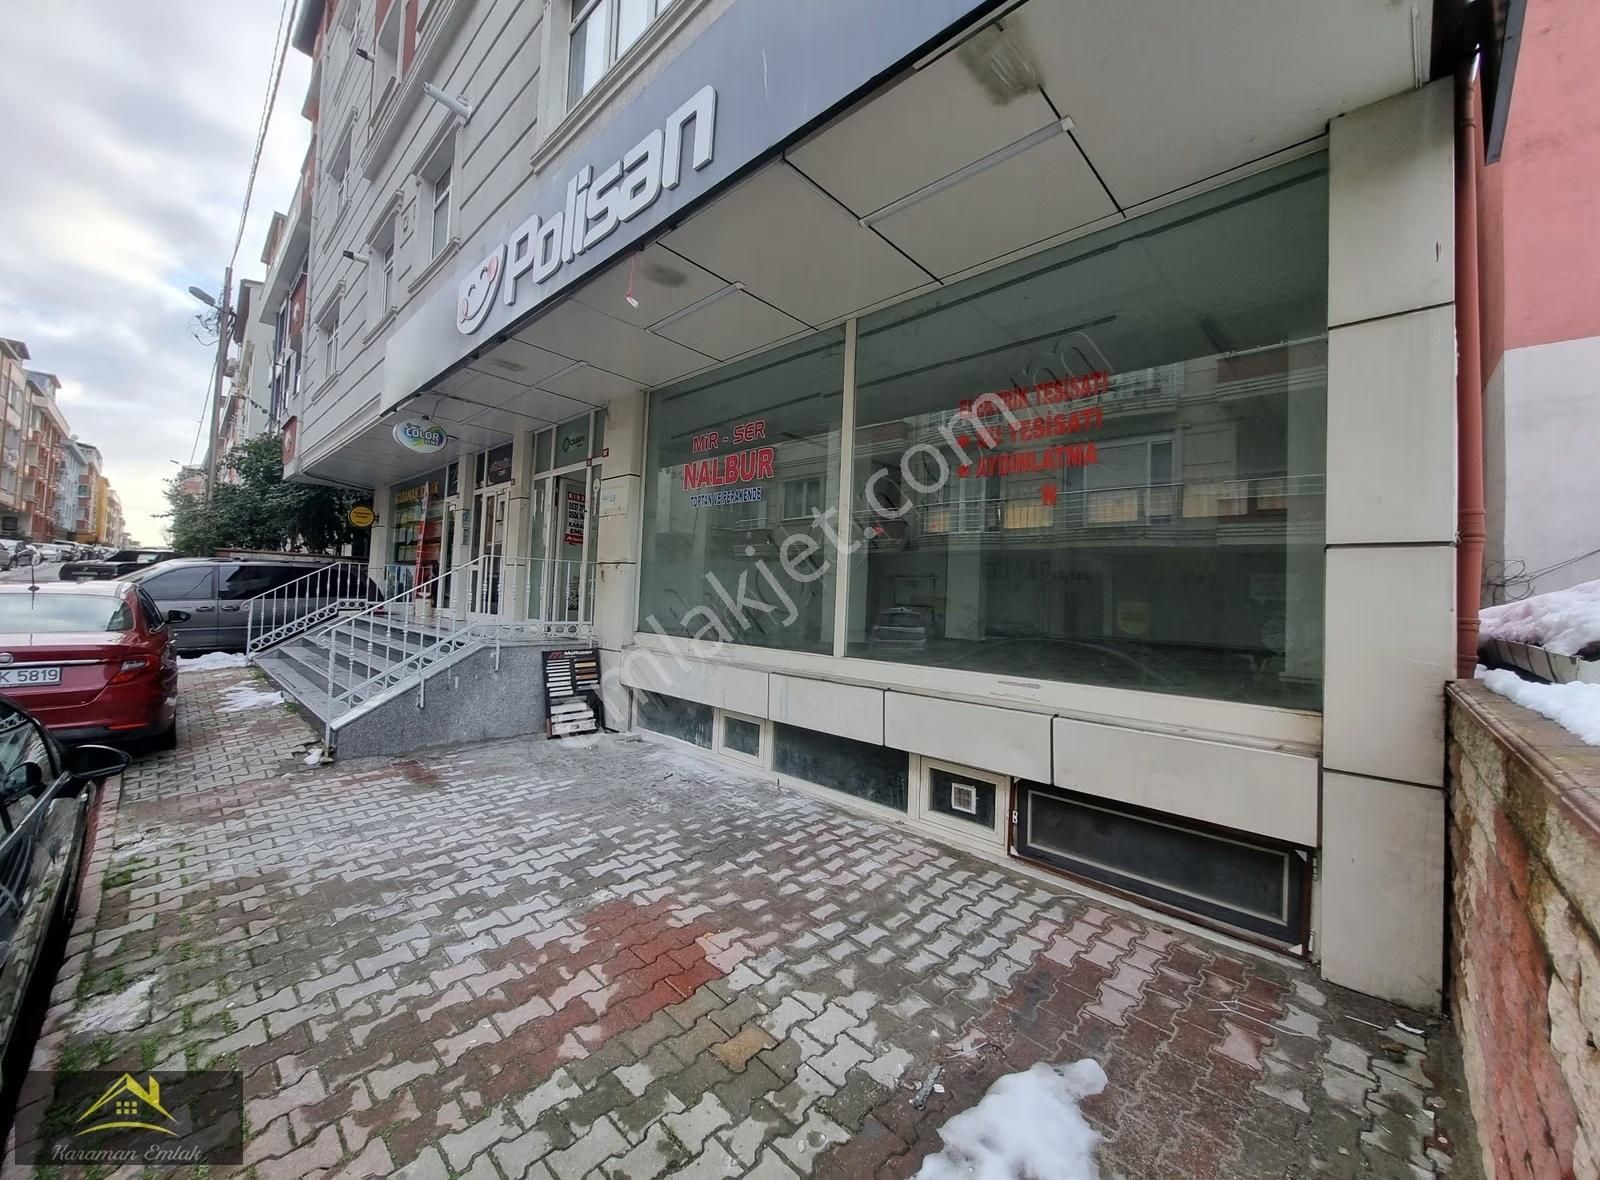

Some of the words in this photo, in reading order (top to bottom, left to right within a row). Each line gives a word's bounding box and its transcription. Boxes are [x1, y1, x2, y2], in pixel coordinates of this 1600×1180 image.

[504, 84, 717, 306] Polisan
[406, 428, 440, 441] COLOR
[733, 420, 767, 445] SER
[682, 447, 775, 492] NALBUR
[17, 669, 58, 682] 5819
